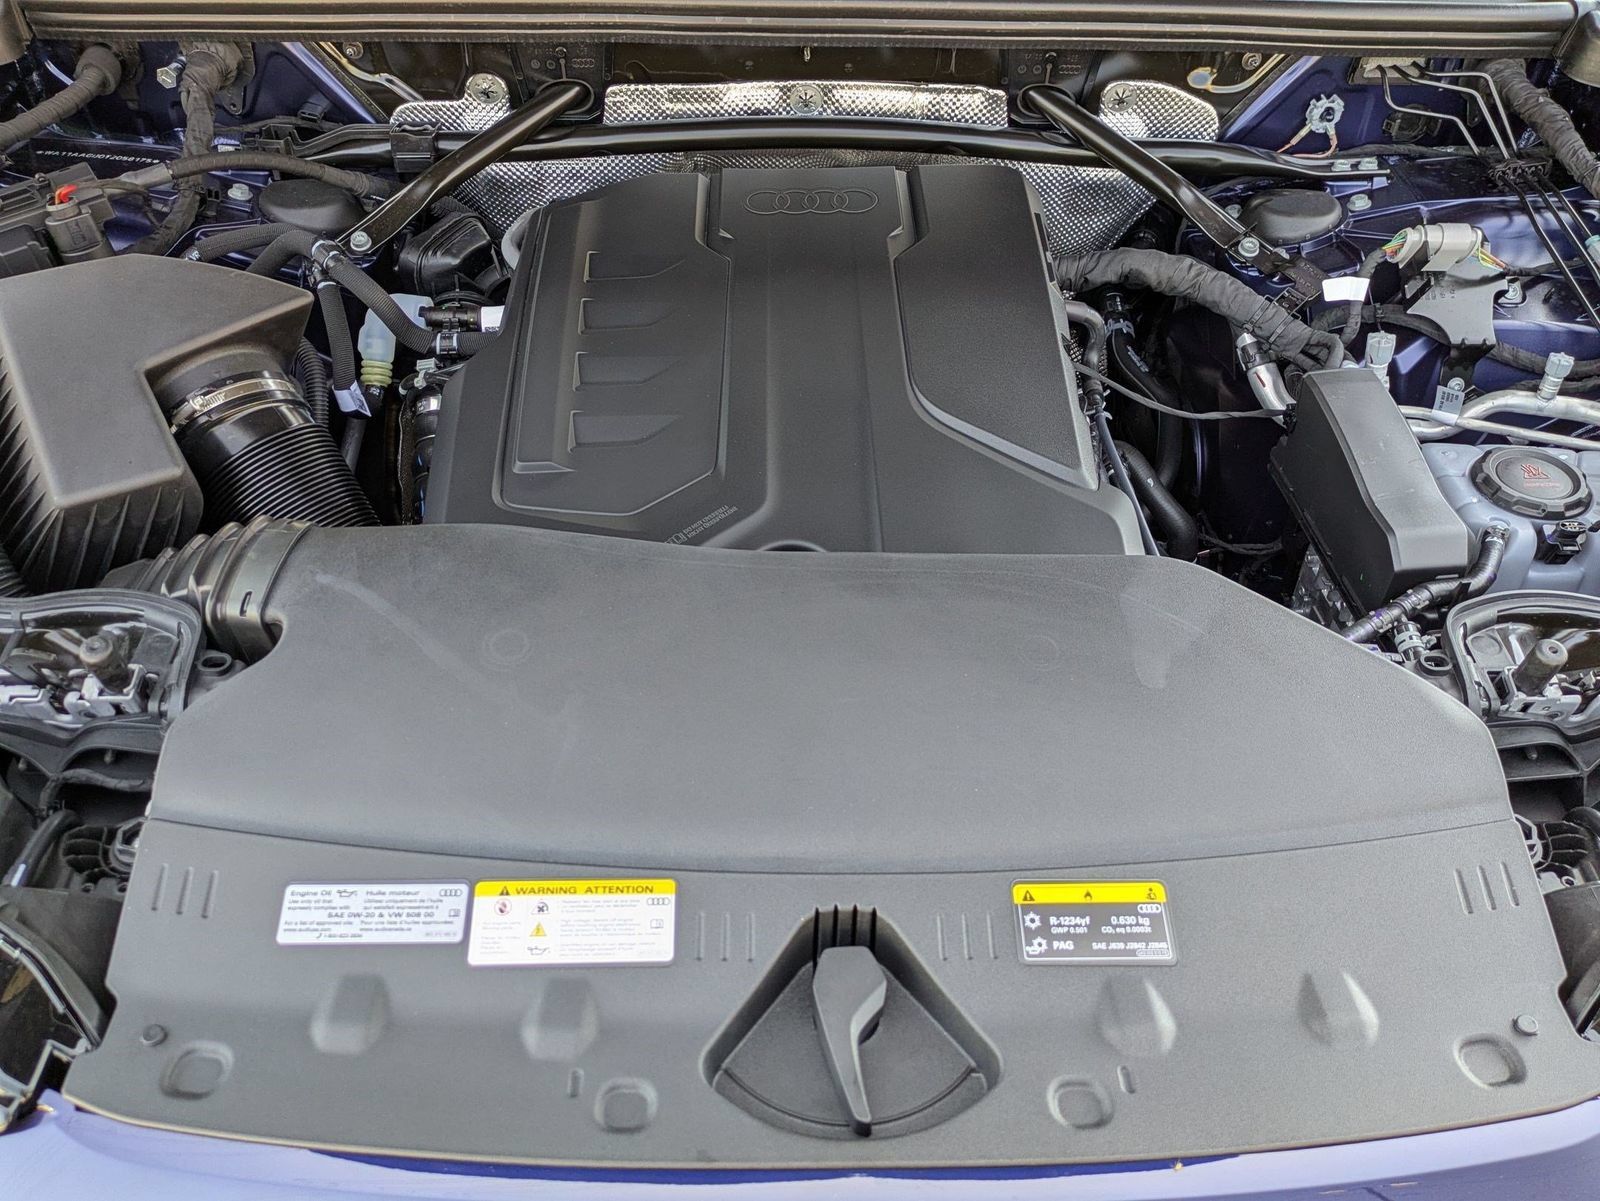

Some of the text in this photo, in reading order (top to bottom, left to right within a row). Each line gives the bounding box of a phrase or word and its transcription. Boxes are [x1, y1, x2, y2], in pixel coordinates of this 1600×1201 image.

[515, 885, 654, 895] WARNING ATTENTION
[1049, 915, 1150, 926] R-1234yf 0.630 kg
[1052, 940, 1074, 950] PAG
